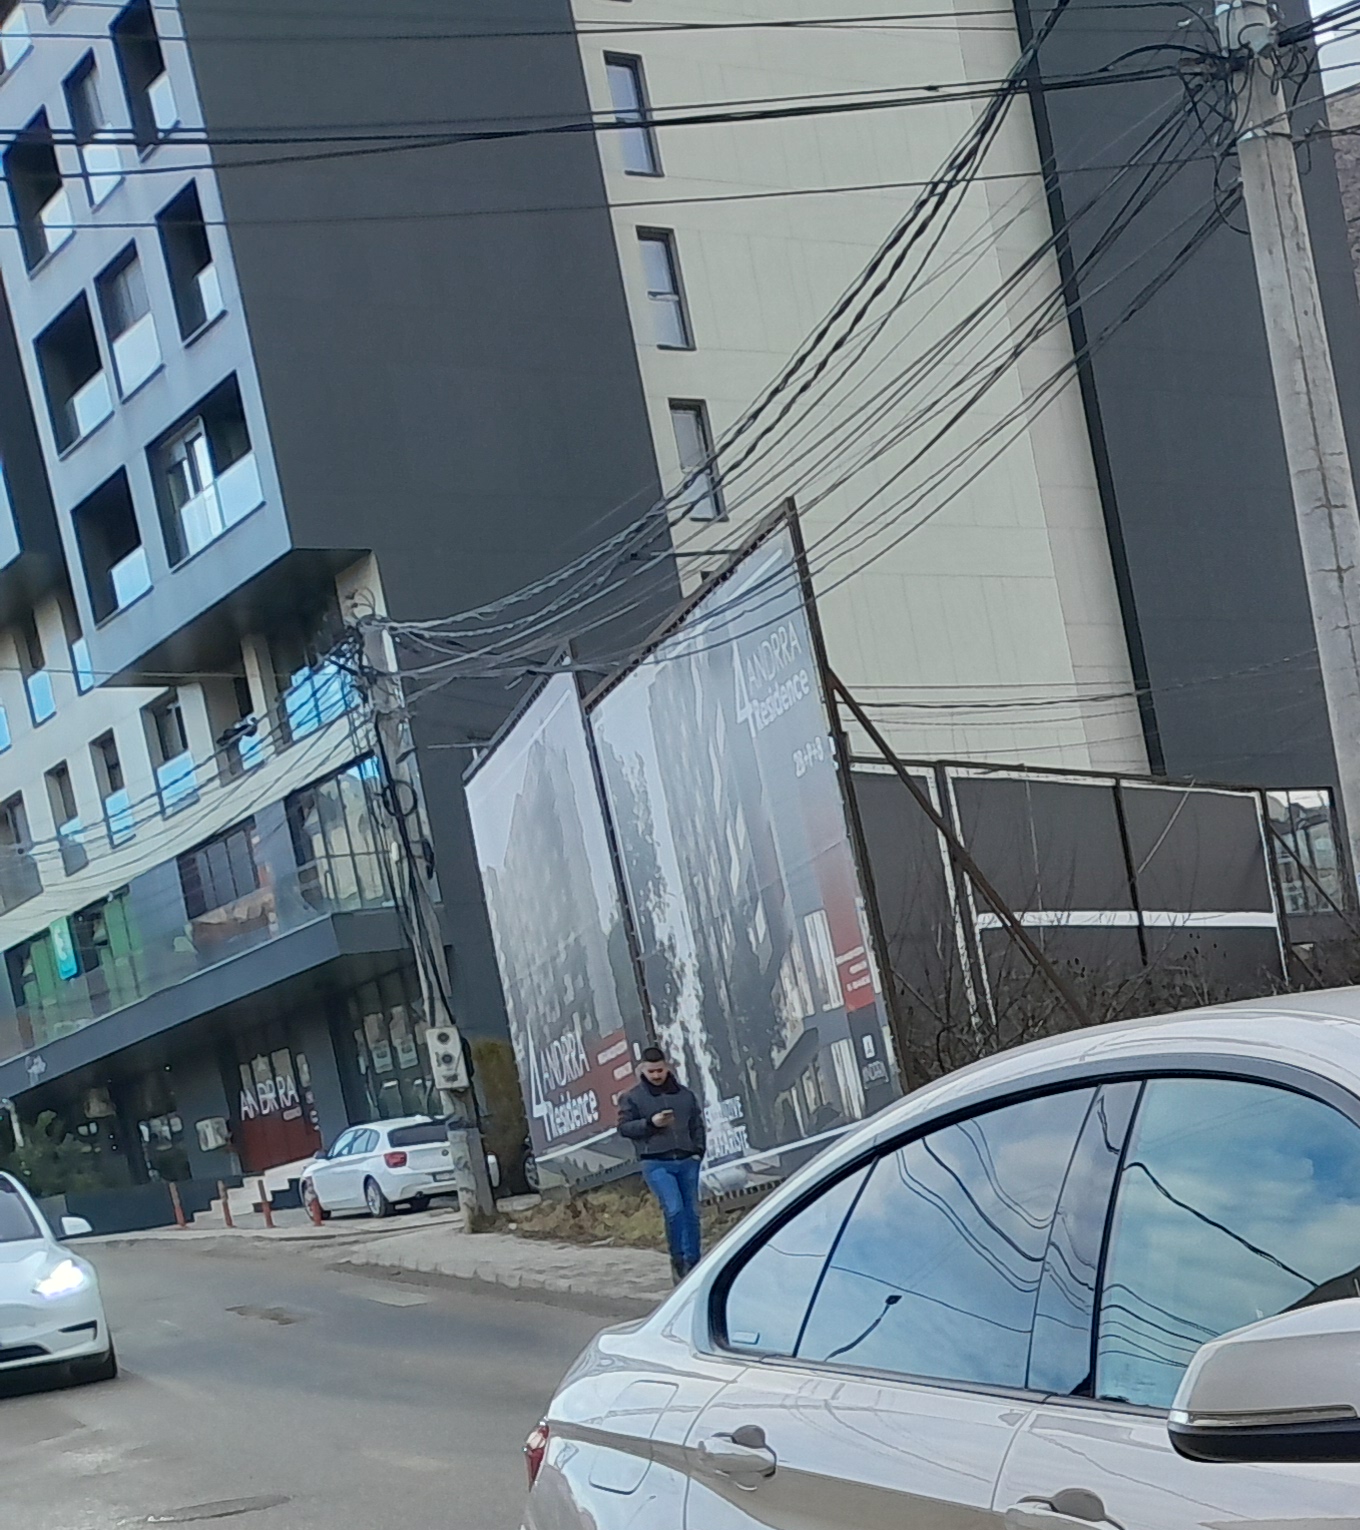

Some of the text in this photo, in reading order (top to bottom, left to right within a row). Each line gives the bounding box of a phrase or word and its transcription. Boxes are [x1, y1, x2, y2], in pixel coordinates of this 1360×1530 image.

[747, 620, 802, 693] ANDRRA
[751, 669, 811, 732] Residence
[240, 1074, 300, 1121] ANDRRA
